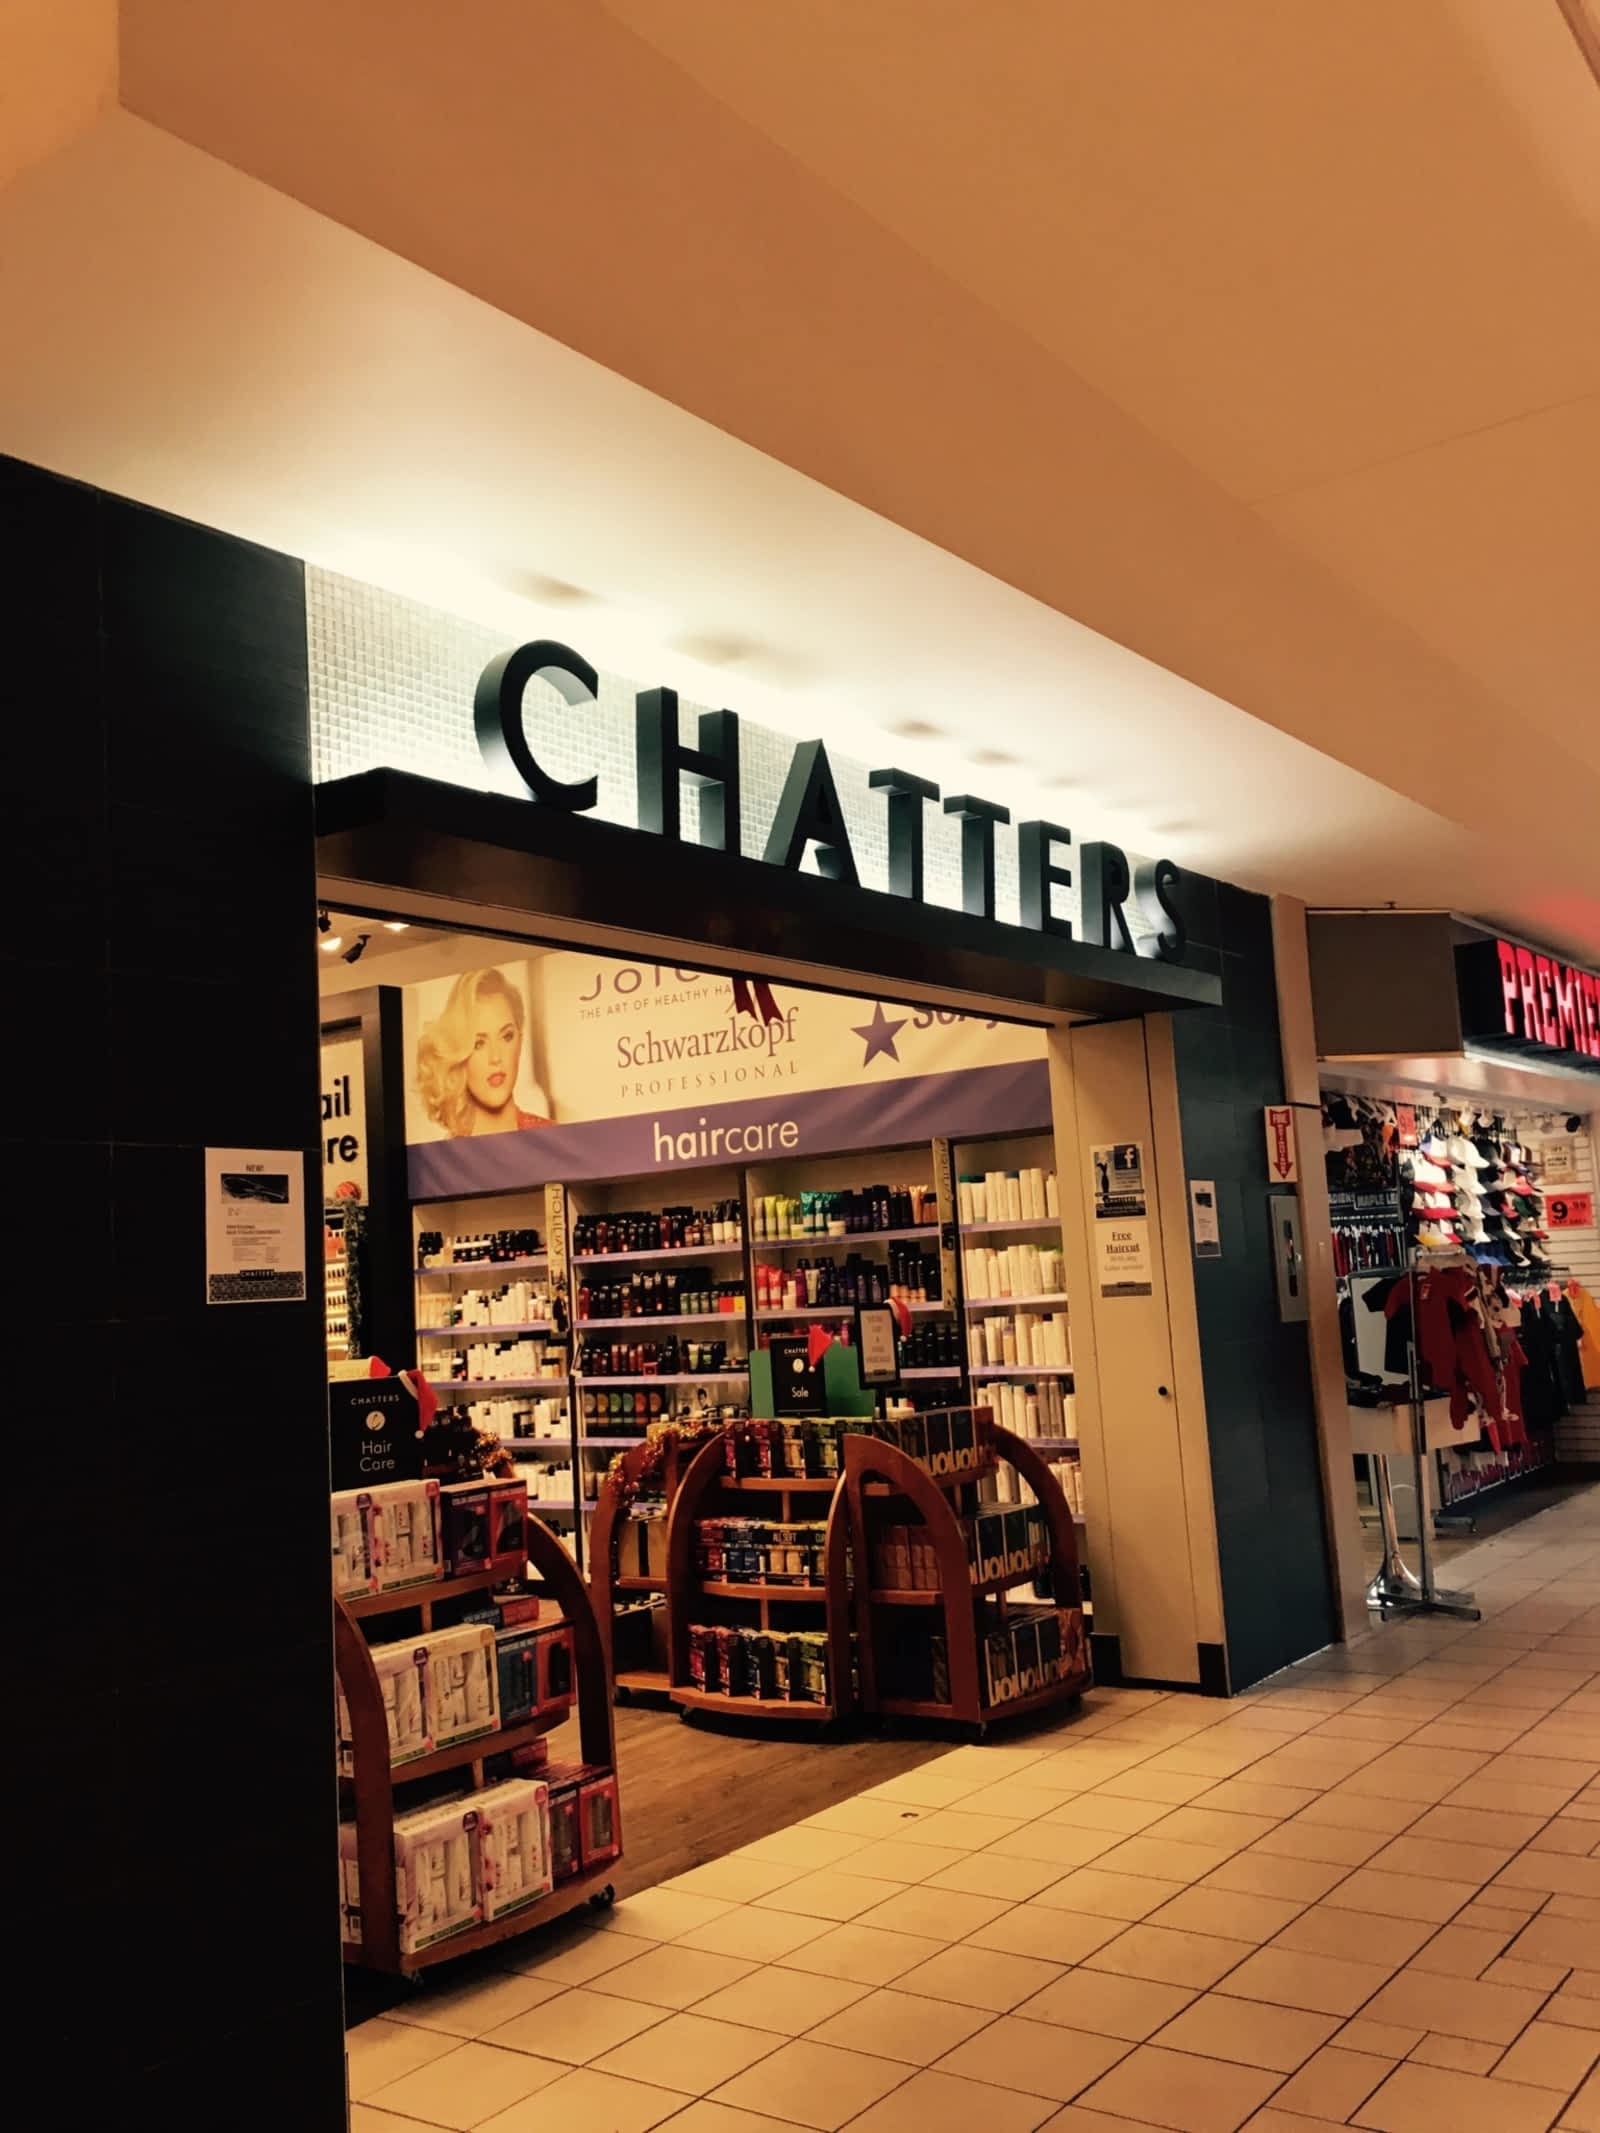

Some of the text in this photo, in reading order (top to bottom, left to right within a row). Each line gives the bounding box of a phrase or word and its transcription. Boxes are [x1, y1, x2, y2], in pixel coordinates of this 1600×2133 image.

[474, 639, 1186, 962] CHATTERS
[580, 983, 733, 1020] THE ART OF HEALTHY HA
[1497, 938, 1600, 1058] PREMIE
[617, 1006, 799, 1069] Schwarzkopf
[620, 1059, 799, 1098] PROFESSIONAL
[321, 1075, 351, 1120] ail
[323, 1134, 359, 1165] re
[653, 1117, 799, 1163] haircare
[1106, 1243, 1141, 1255] Haircut
[1112, 1231, 1132, 1241] Free
[784, 1346, 808, 1355] CHATTER
[350, 1393, 400, 1406] CHATTERS
[791, 1385, 809, 1398] Sale
[361, 1440, 393, 1455] Hair
[359, 1456, 396, 1472] Care
